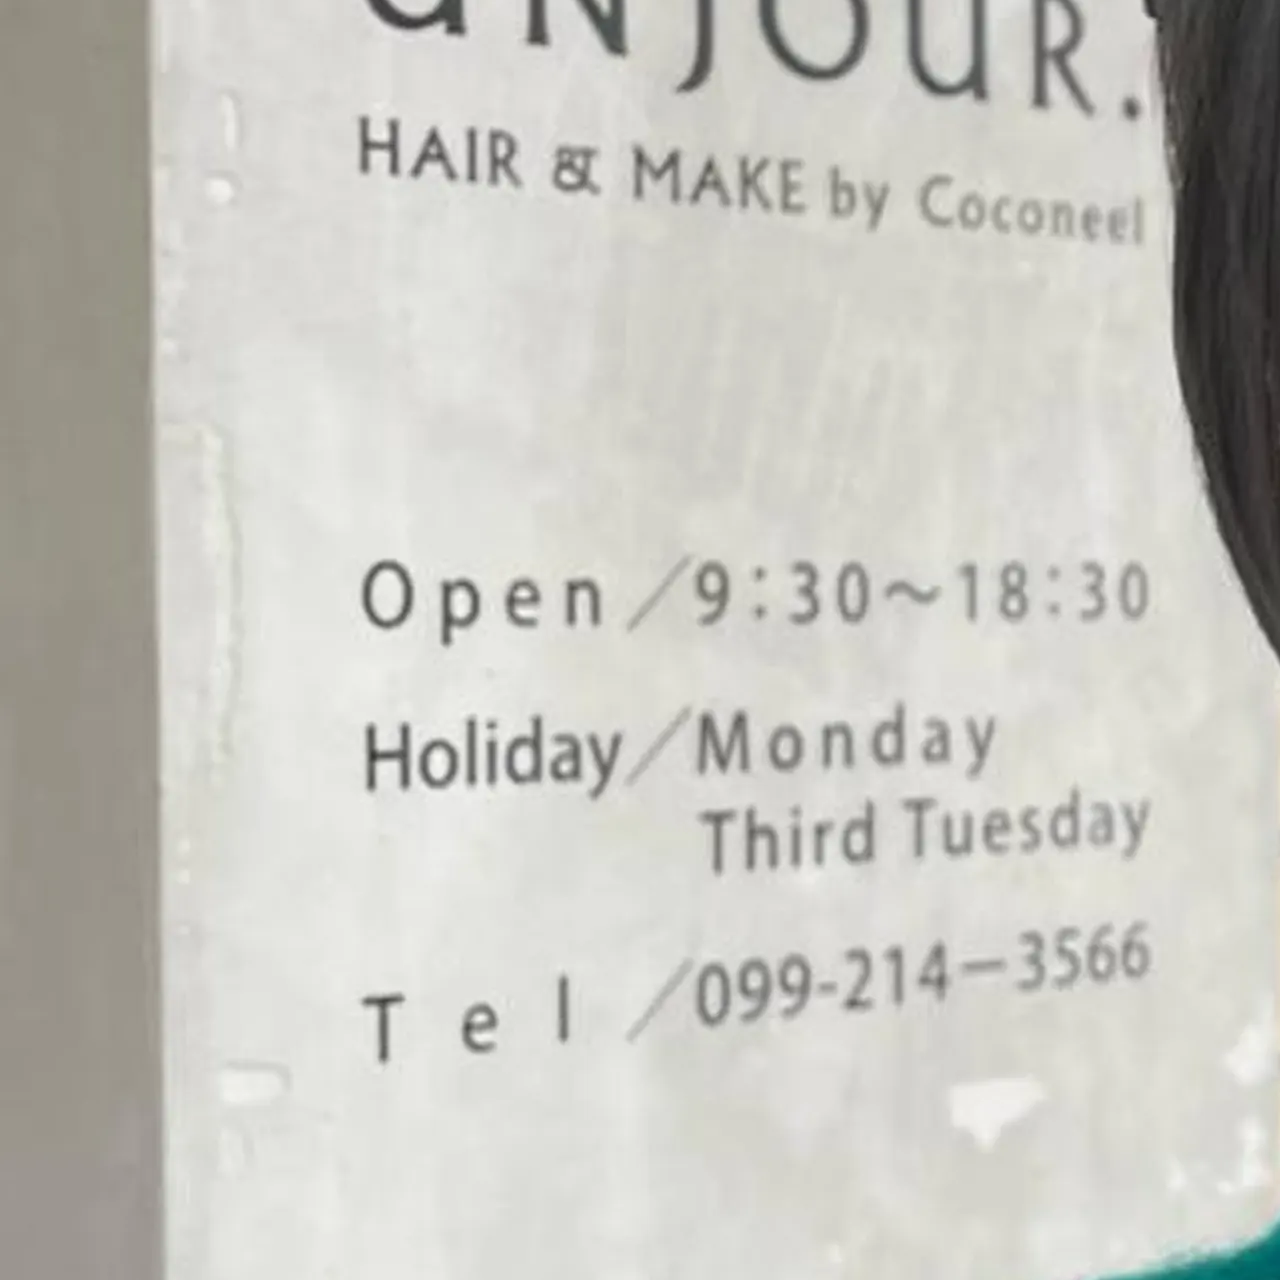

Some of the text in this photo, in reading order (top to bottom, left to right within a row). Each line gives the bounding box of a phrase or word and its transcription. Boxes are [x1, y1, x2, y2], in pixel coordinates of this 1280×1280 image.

[357, 115, 1146, 246] HAIR & MAKE by Coconeel
[698, 787, 1152, 875] Third Tuesday
